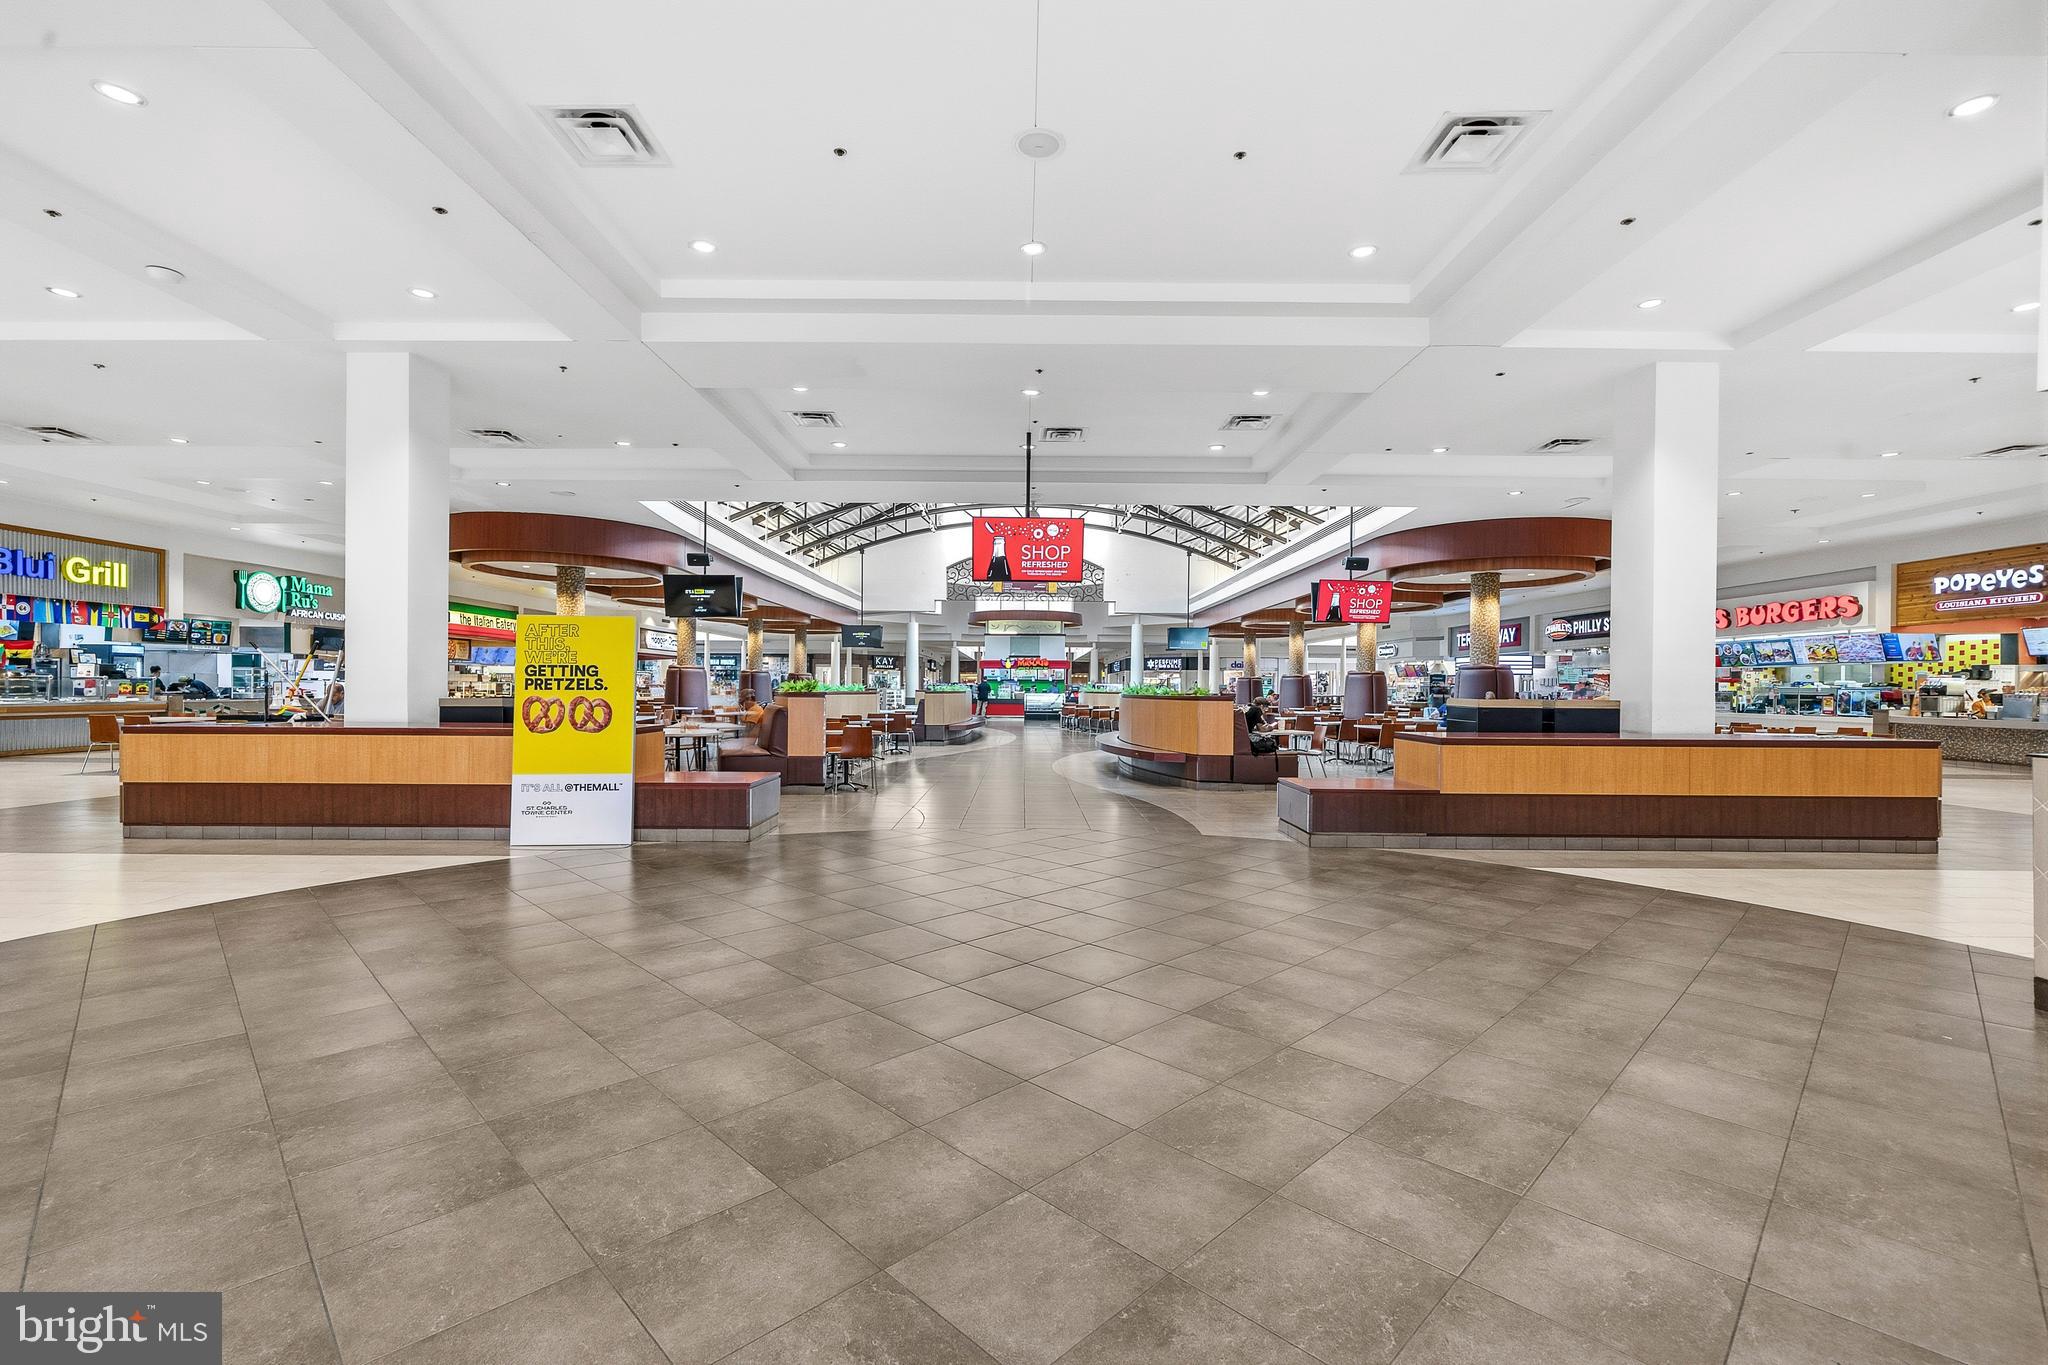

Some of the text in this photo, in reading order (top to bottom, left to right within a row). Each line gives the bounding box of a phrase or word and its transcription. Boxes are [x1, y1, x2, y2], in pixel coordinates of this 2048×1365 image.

[1021, 544, 1071, 560] SHOP
[63, 556, 127, 588] Grill
[290, 575, 334, 597] Mama
[290, 591, 319, 610] Ru's
[1349, 598, 1383, 609] SHOP
[1938, 594, 2038, 609] LOUISIANA KITCHEN
[290, 608, 345, 621] AFRICAN CUISIN
[1736, 595, 1860, 628] BURGERS
[459, 613, 517, 633] the Italian Eatery
[524, 624, 580, 637] AFTER
[1573, 619, 1602, 635] PHILLY
[525, 637, 571, 652] THIS,
[524, 650, 578, 664] WE'RE
[875, 656, 894, 665] KAY
[524, 664, 599, 677] GETTING
[524, 677, 608, 691] PRETZELS.
[520, 783, 541, 793] IT'S
[542, 783, 563, 792] ALL
